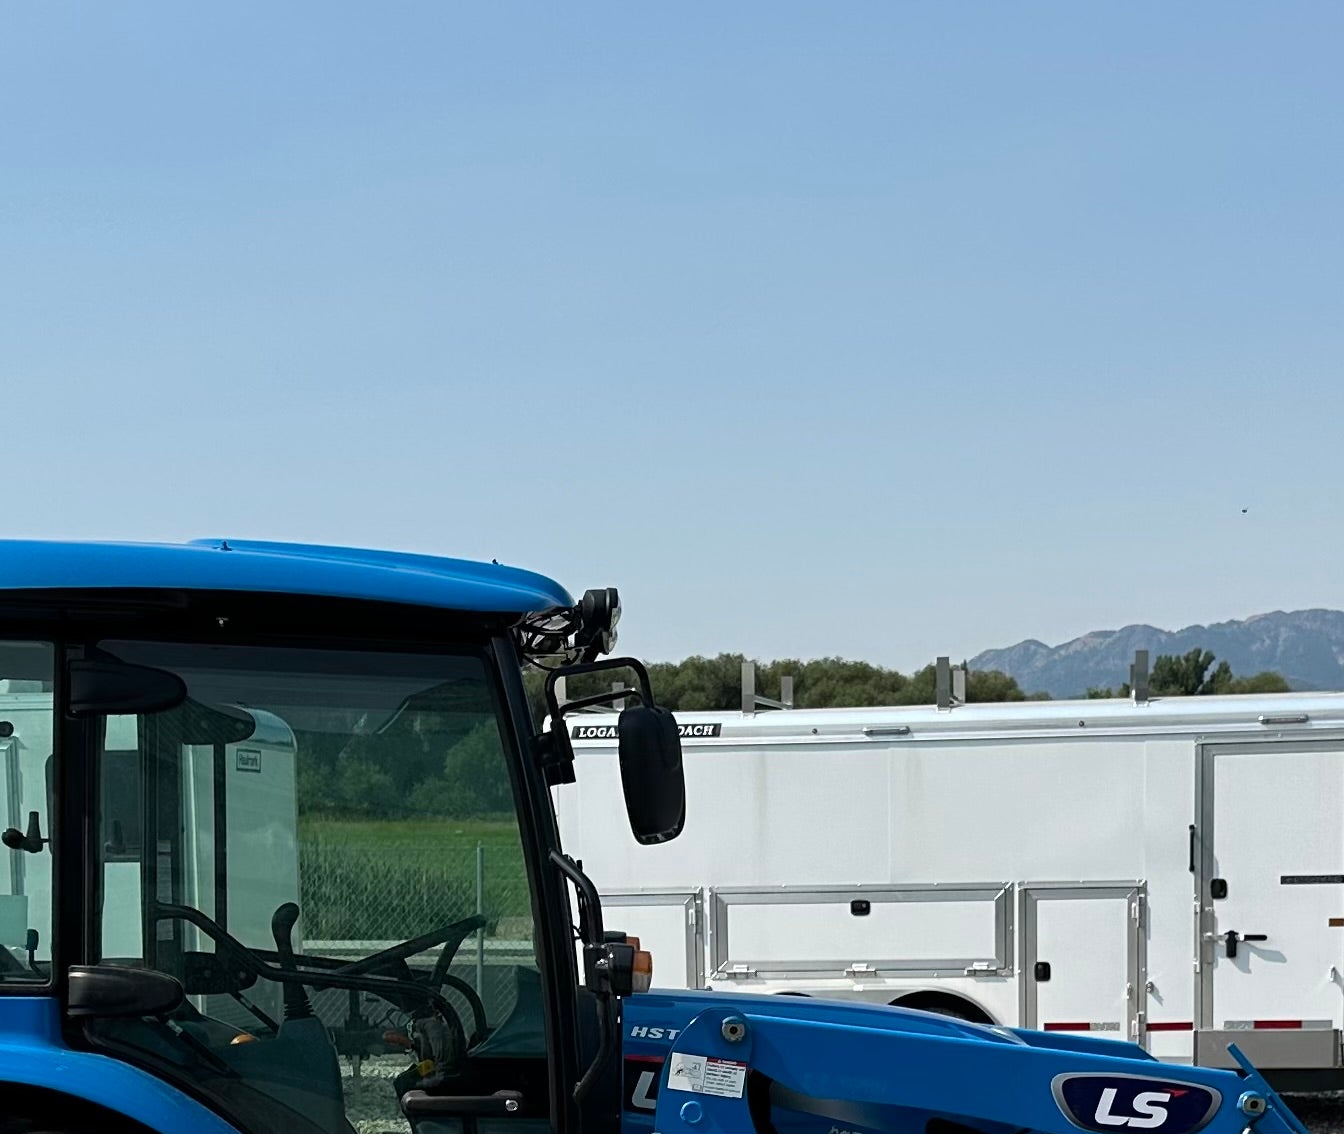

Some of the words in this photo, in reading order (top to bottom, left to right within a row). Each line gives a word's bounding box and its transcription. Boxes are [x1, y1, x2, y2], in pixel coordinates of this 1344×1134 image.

[578, 727, 619, 738] LOGA
[678, 725, 714, 736] OACH
[631, 1026, 680, 1040] HST
[1094, 1088, 1171, 1128] LS
